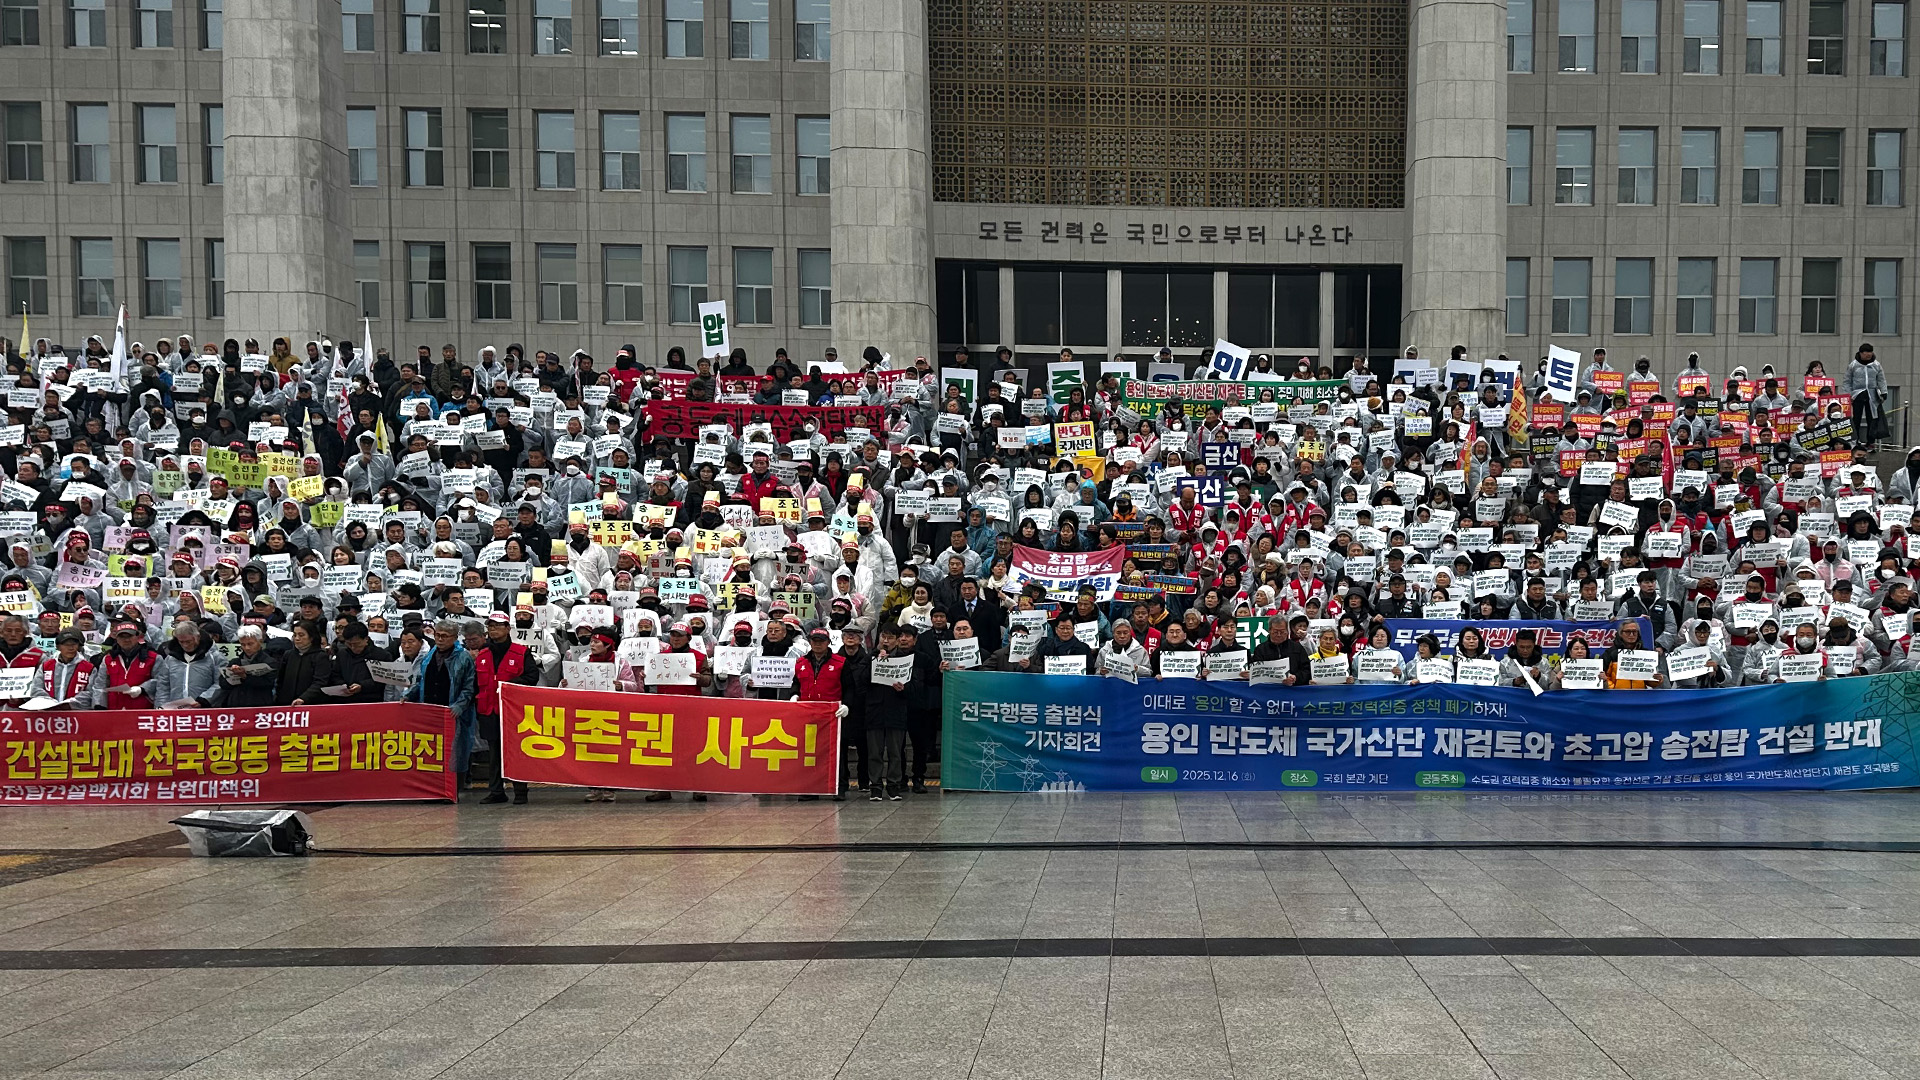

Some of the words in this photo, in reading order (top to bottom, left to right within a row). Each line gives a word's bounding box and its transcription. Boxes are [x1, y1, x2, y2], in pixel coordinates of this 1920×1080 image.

[979, 221, 1023, 242] 모든
[1041, 221, 1109, 243] 권력은
[1126, 222, 1266, 245] 국민으로부터
[1285, 224, 1353, 246] 나온다
[703, 313, 725, 347] 압
[1548, 357, 1575, 392] 토
[1126, 381, 1145, 398] 용인
[1177, 383, 1215, 400] 국가산단
[1278, 387, 1294, 399] 주민
[1057, 424, 1091, 439] 반도체
[213, 451, 238, 461] 송전탑
[1204, 445, 1238, 467] 금산
[232, 464, 260, 473] 송전탑
[234, 473, 257, 481] OUT
[592, 522, 631, 532] 무조건
[835, 518, 856, 529] 송전
[214, 544, 242, 554] 송전탑
[1048, 553, 1088, 565] 초고압
[70, 565, 103, 578] 송전탑
[111, 579, 143, 588] 송전탑
[661, 580, 698, 591] 송전탑
[114, 589, 139, 597] OUT
[776, 593, 814, 605] 송전탑
[790, 606, 807, 618] UT
[1143, 694, 1186, 710] 이대로
[1247, 699, 1262, 714] 수
[1266, 699, 1298, 717] 없다,
[1303, 700, 1346, 715] 수도권
[1351, 699, 1407, 715] 전력집중
[1412, 699, 1441, 714] 정책
[1445, 700, 1507, 717] 폐기하자!
[960, 701, 1039, 725] 전국행동
[1045, 704, 1102, 726] 출범식
[137, 715, 214, 733] 국회본관
[218, 713, 236, 730] 앞
[254, 711, 310, 729] 청와대
[517, 704, 675, 767] 생존권
[696, 716, 818, 771] 사수!
[1024, 730, 1101, 752] 기자회견
[1141, 722, 1199, 755] 용인
[1210, 724, 1297, 758] 반도체
[1307, 726, 1426, 758] 국가산단
[1433, 728, 1555, 761] 재검토와
[1563, 731, 1653, 762] 초고압
[1661, 728, 1750, 761] 송전탑
[1757, 724, 1815, 755] 건설
[1824, 718, 1882, 751] 반대
[5, 738, 134, 781] 건설반대
[143, 735, 270, 778] 전국행동
[279, 732, 340, 773] 출범
[351, 728, 444, 773] 대행진
[1150, 769, 1169, 781] 일시
[1182, 769, 1239, 782] 2025.12.16
[1290, 773, 1309, 784] 장소
[1323, 773, 1343, 785] 국회
[1346, 773, 1366, 785] 본관
[1422, 773, 1459, 785] 공동주최
[1471, 775, 1499, 785] 수도권
[1502, 775, 1539, 786] 전력집중
[157, 779, 260, 800] 남원대책위
